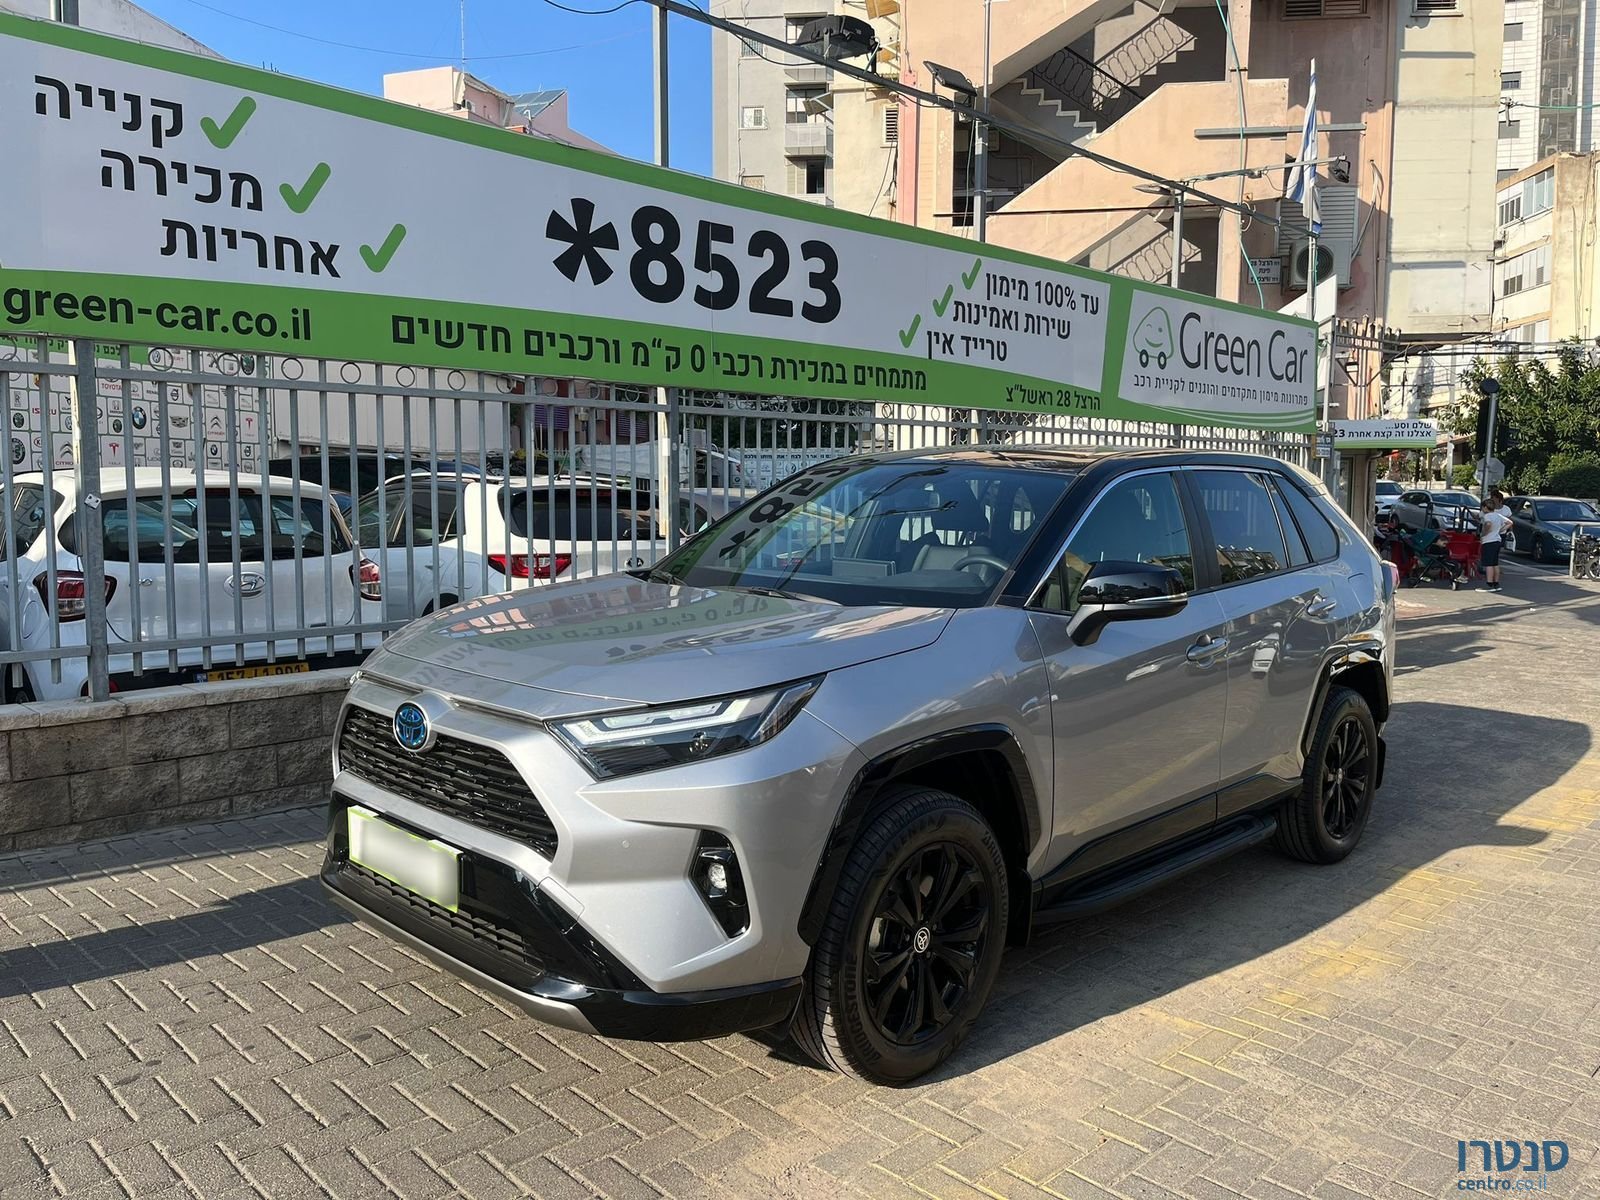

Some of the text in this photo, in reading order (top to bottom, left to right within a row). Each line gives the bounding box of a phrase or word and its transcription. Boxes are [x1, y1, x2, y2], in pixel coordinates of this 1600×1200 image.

[34, 74, 183, 149] קנייה
[100, 148, 263, 212] מכירה
[160, 218, 341, 279] אחריות
[985, 272, 1099, 315] עד 100% מימון
[3, 287, 311, 341] green-car.co.il
[952, 300, 1071, 340] שירות ואמינות
[391, 314, 512, 354] חדשים
[523, 329, 621, 367] ורכבים
[926, 330, 1008, 361] טרייד אין
[1179, 311, 1308, 384] Green Car
[690, 344, 706, 373] 0
[713, 351, 764, 378] רכבי
[770, 356, 848, 385] במכירת
[853, 364, 927, 391] מתמחים
[1133, 373, 1308, 406] פתרונות מימון מתקדמים והוגנים לקניית רכב
[1005, 383, 1101, 410] הרצל 28 ראשל"צ
[1348, 430, 1372, 438] אחרת
[1373, 430, 1392, 439] קצת
[1407, 429, 1432, 438] אצלנו
[1412, 420, 1432, 429] שלם
